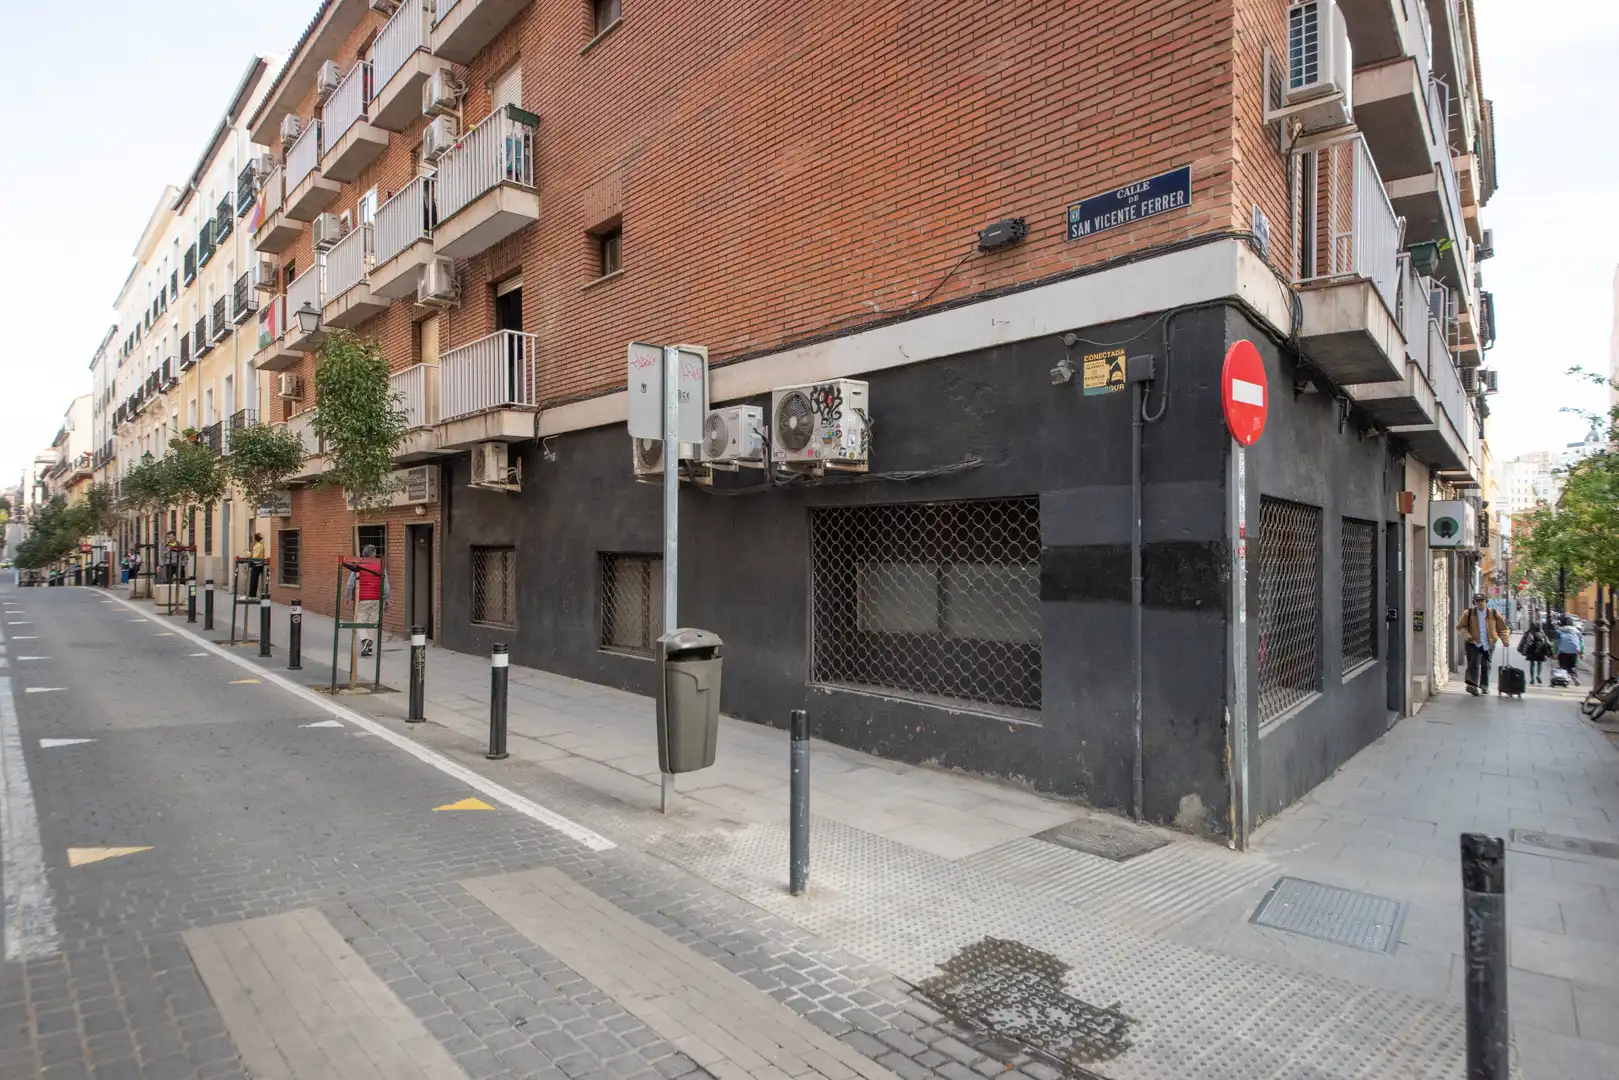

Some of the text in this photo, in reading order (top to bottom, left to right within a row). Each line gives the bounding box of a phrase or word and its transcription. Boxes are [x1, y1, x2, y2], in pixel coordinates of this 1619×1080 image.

[1116, 181, 1150, 199] CALLE
[1128, 194, 1140, 203] DE
[1071, 190, 1184, 237] SAN VICENTE FERRER
[1084, 349, 1125, 362] CONECTADA
